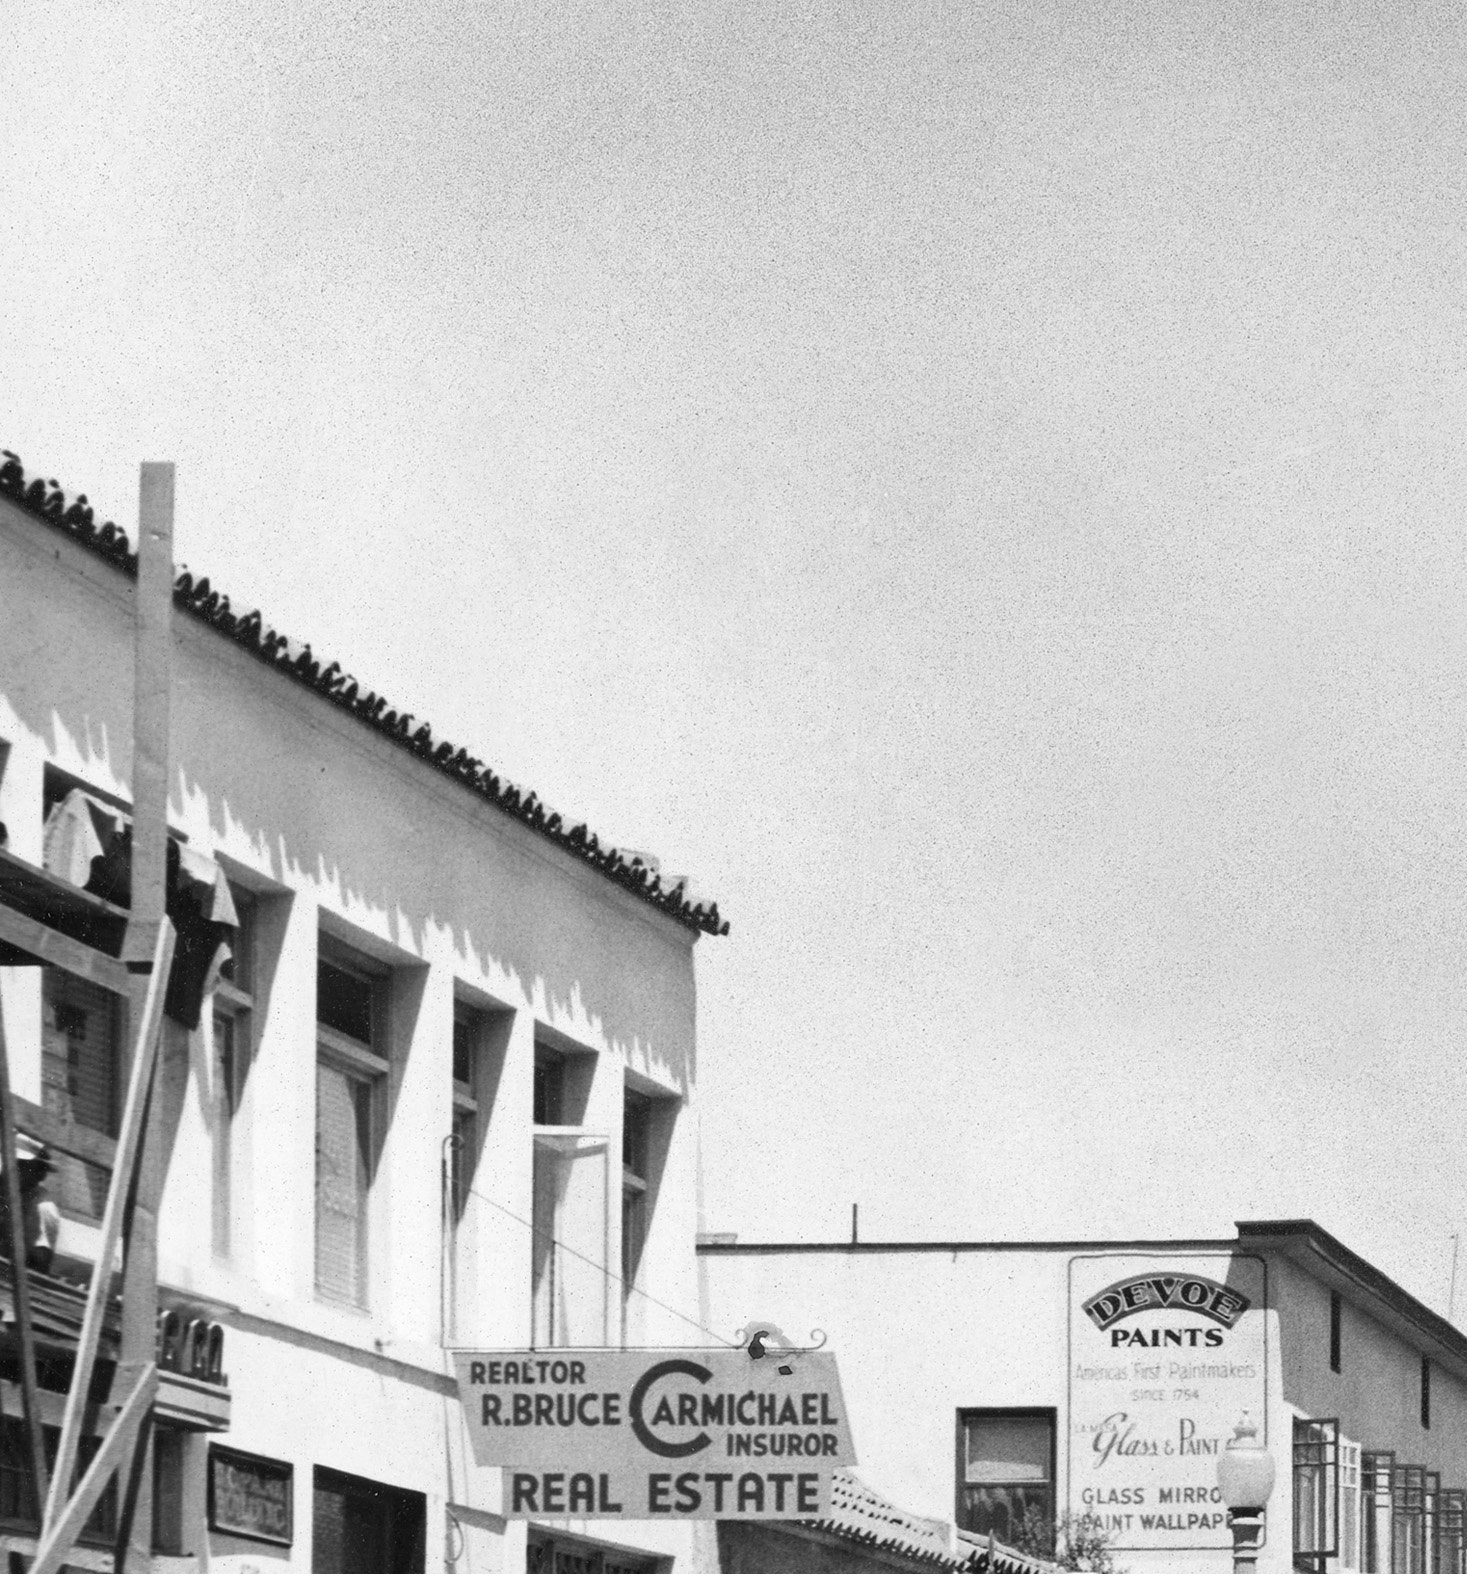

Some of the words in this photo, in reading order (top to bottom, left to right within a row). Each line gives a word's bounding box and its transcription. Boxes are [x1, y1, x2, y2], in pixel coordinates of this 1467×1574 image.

[1091, 1278, 1242, 1324] DEVOE
[1111, 1328, 1223, 1347] PAINTS
[470, 1361, 585, 1384] REALTOR
[630, 1359, 838, 1458] CARMICHAEL
[727, 1433, 838, 1456] INSUROR
[1093, 1412, 1159, 1469] Glass
[512, 1473, 622, 1512] REAL
[649, 1473, 819, 1512] ESTATE
[1082, 1488, 1145, 1504] GLASS
[1159, 1487, 1222, 1504] MIRRO
[1140, 1513, 1233, 1530] WALLPAPE
